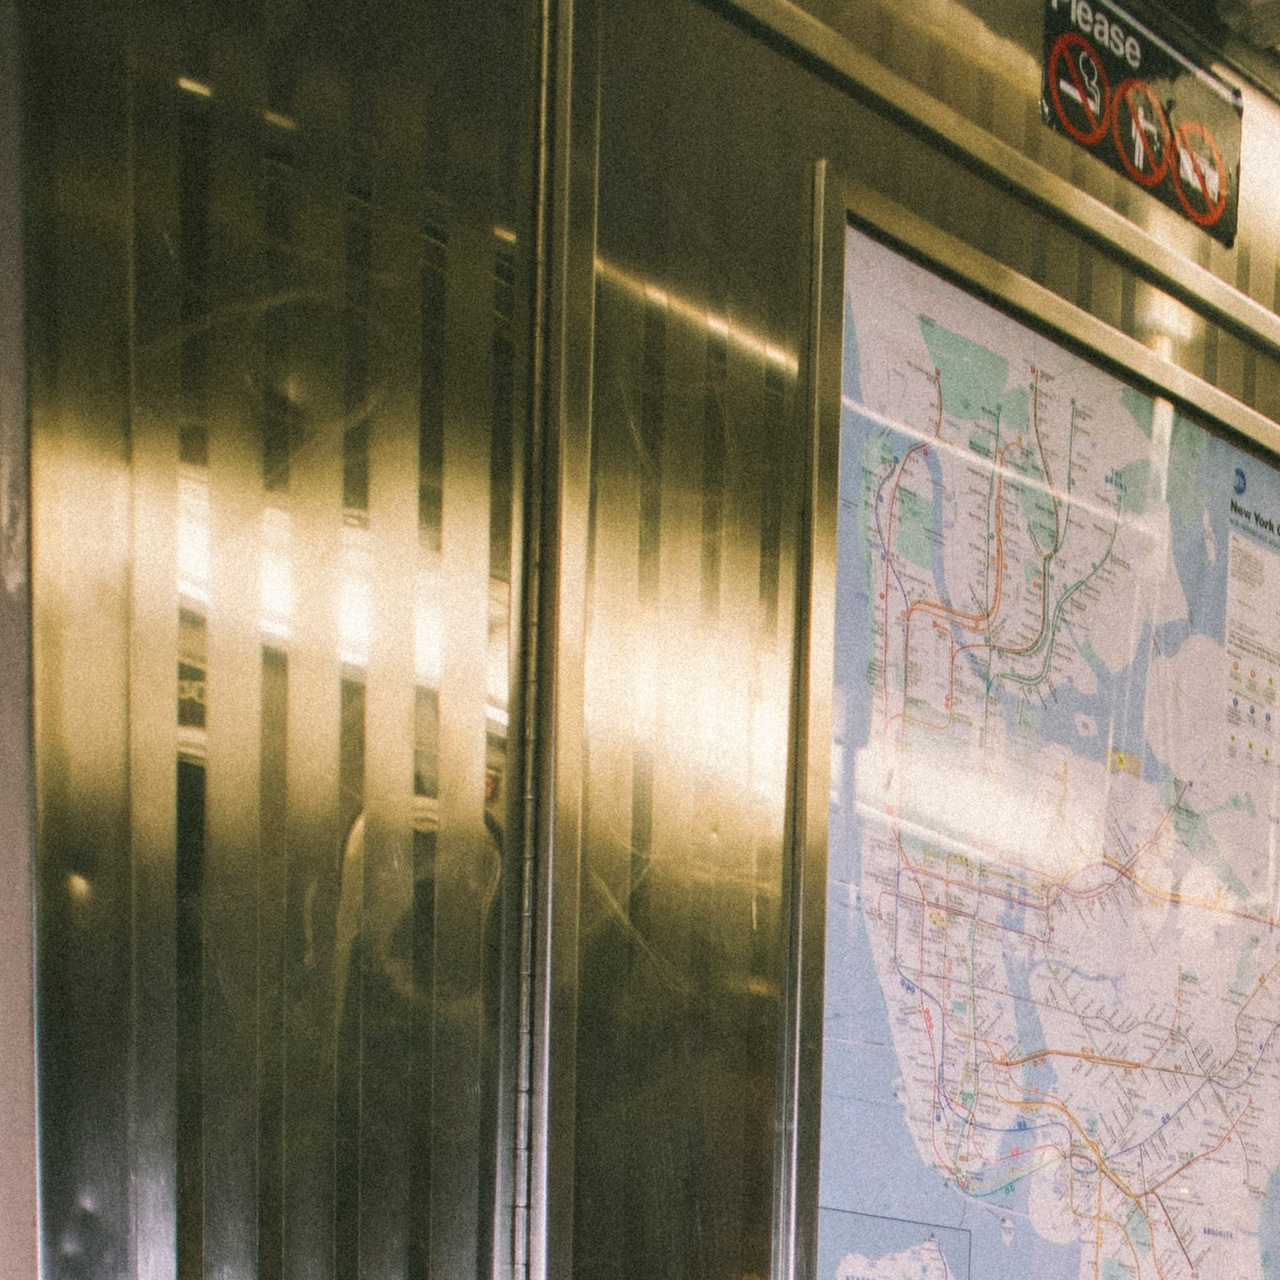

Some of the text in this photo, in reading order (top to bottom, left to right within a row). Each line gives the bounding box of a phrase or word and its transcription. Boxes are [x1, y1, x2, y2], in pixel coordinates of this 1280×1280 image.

[1051, 0, 1141, 68] lease
[1230, 498, 1252, 520] New
[1253, 511, 1275, 533] York
